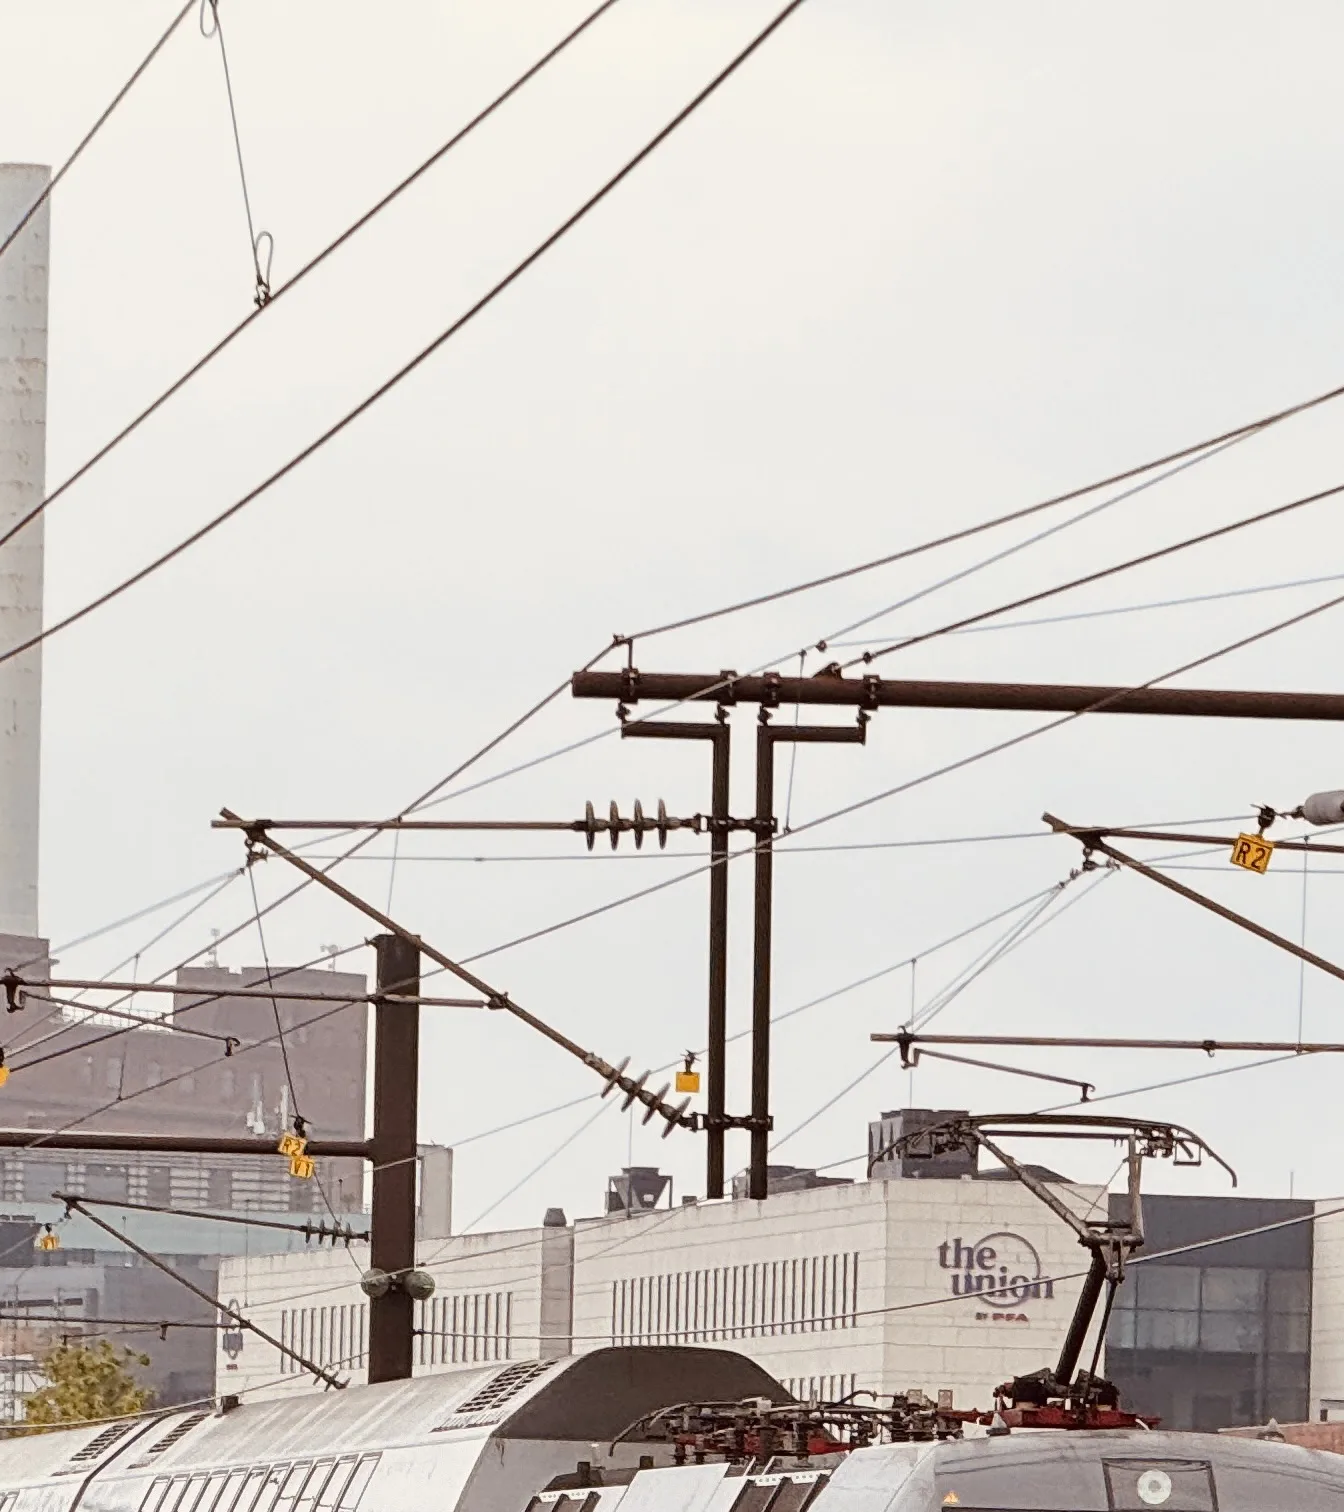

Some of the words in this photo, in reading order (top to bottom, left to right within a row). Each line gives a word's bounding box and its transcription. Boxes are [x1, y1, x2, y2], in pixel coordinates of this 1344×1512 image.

[1234, 842, 1267, 870] R2
[937, 1237, 997, 1271] the
[950, 1265, 1054, 1299] union
[991, 1312, 1030, 1322] PFA
